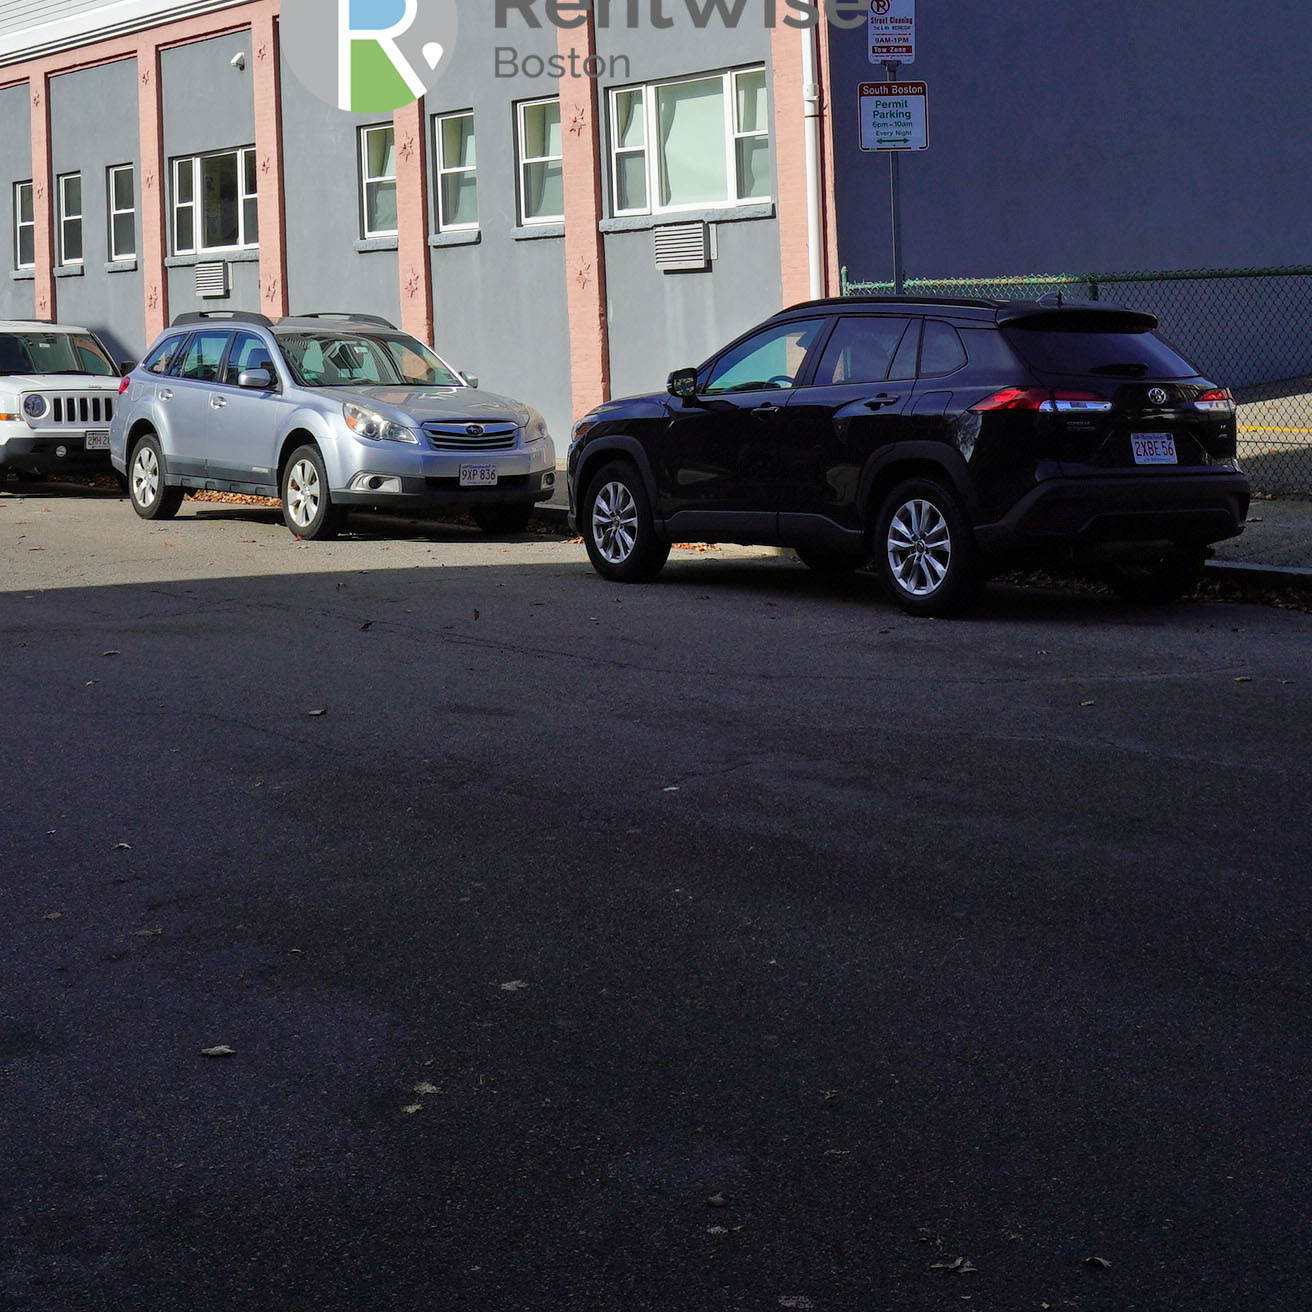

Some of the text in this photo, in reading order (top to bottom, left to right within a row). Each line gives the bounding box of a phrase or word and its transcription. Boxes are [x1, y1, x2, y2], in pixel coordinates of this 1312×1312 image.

[870, 16, 913, 25] Street Cleaning
[863, 85, 923, 95] South Boston
[875, 99, 908, 109] Permit
[872, 110, 912, 120] Parking
[1135, 440, 1174, 457] 2XBE 56
[462, 469, 496, 481] 9XP 836
